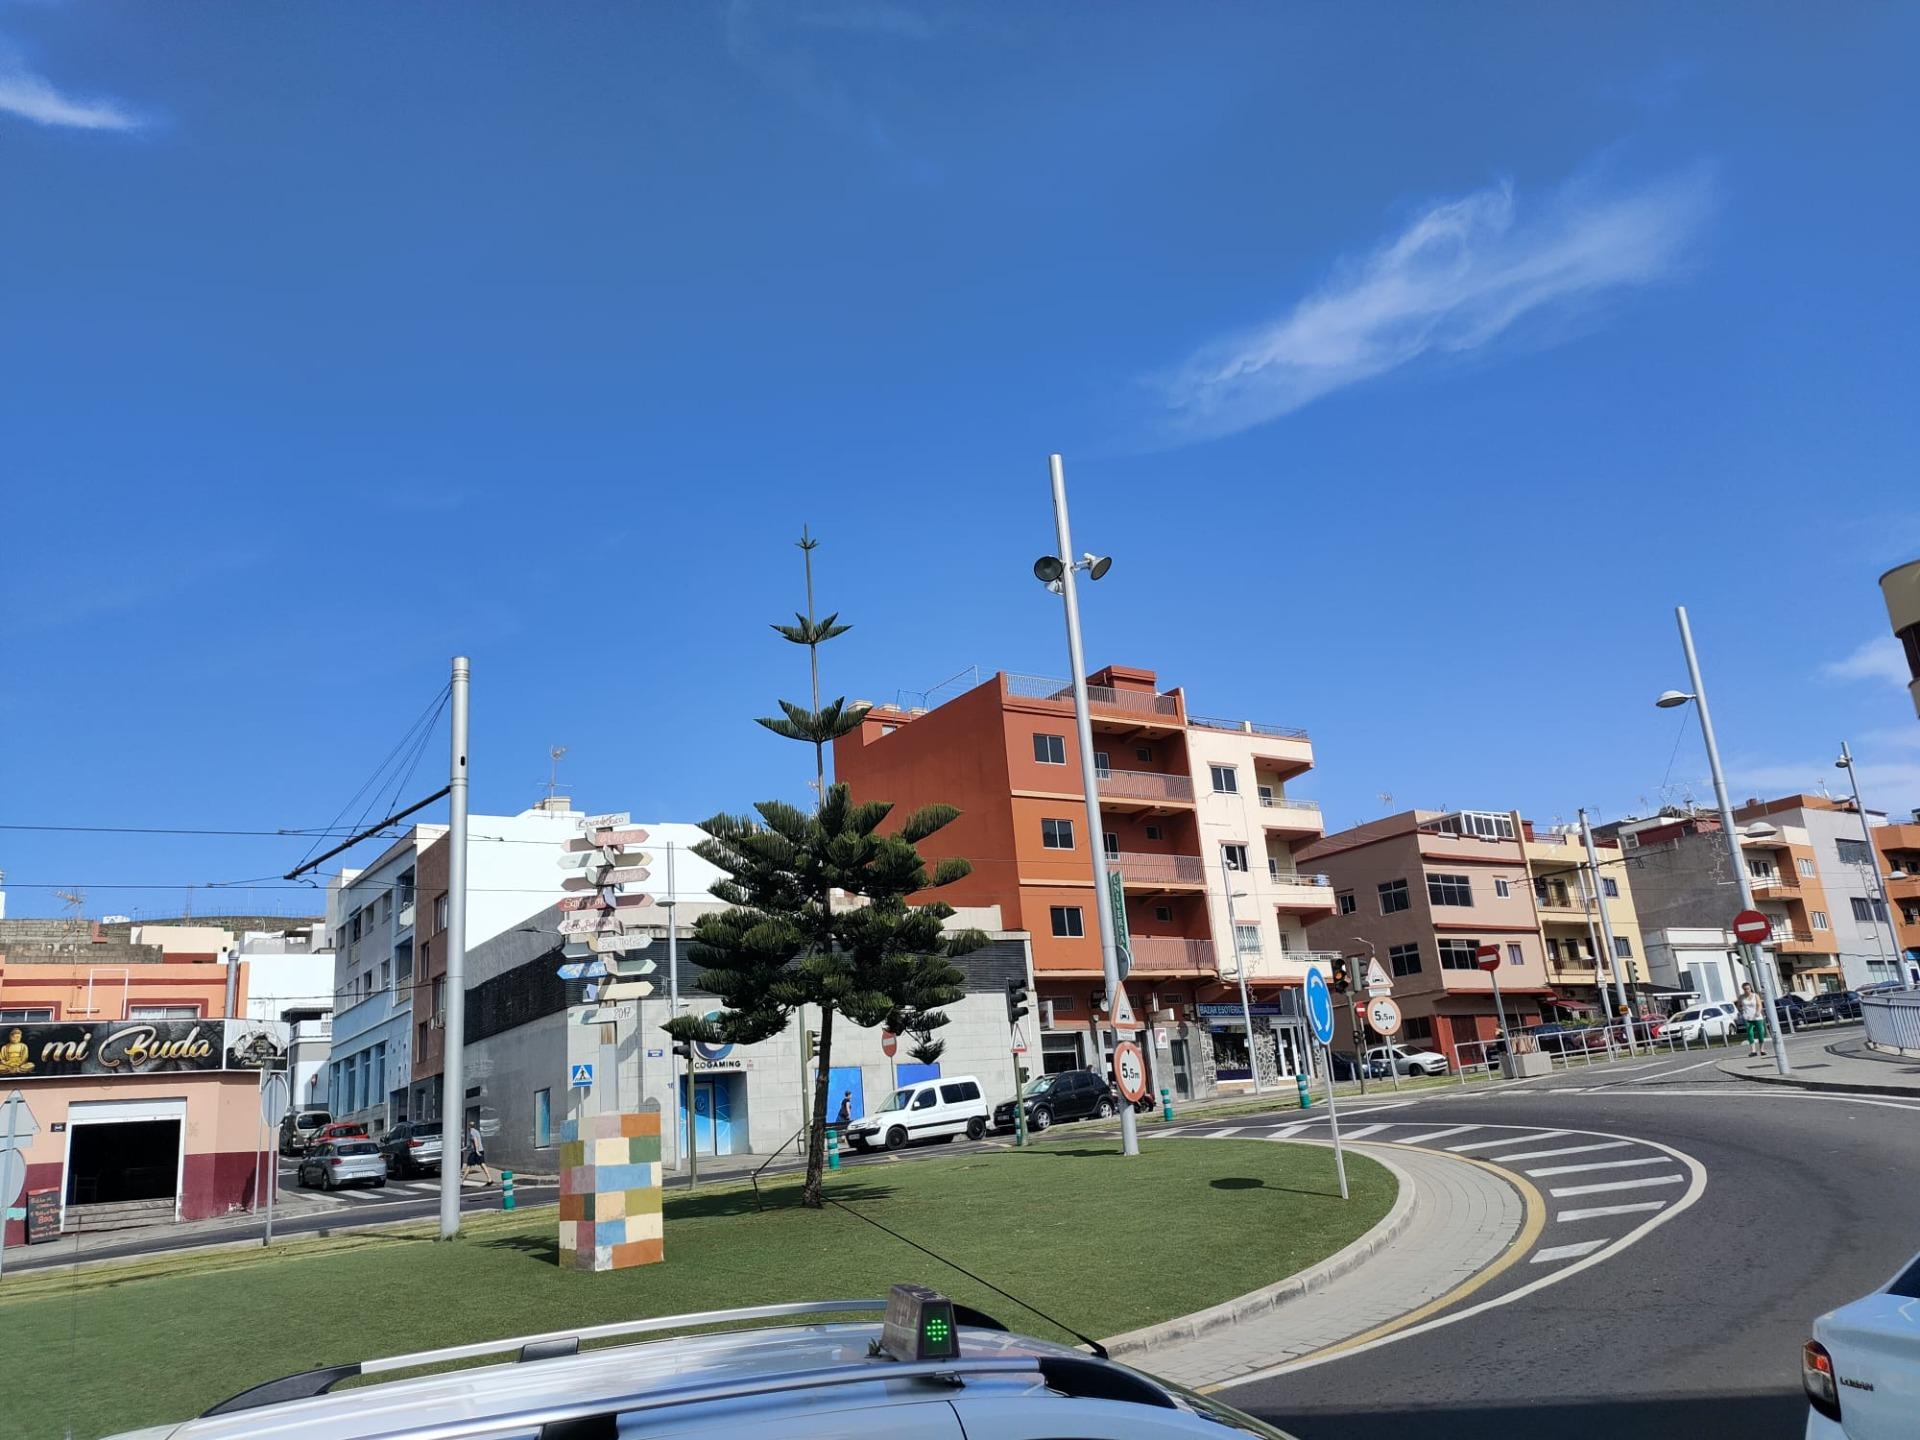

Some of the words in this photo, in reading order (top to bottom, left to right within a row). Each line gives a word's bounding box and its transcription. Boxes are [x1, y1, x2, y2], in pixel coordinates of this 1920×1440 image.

[1112, 874, 1127, 949] UNIVERSA
[41, 1032, 92, 1062] mi
[98, 1025, 213, 1068] Buda
